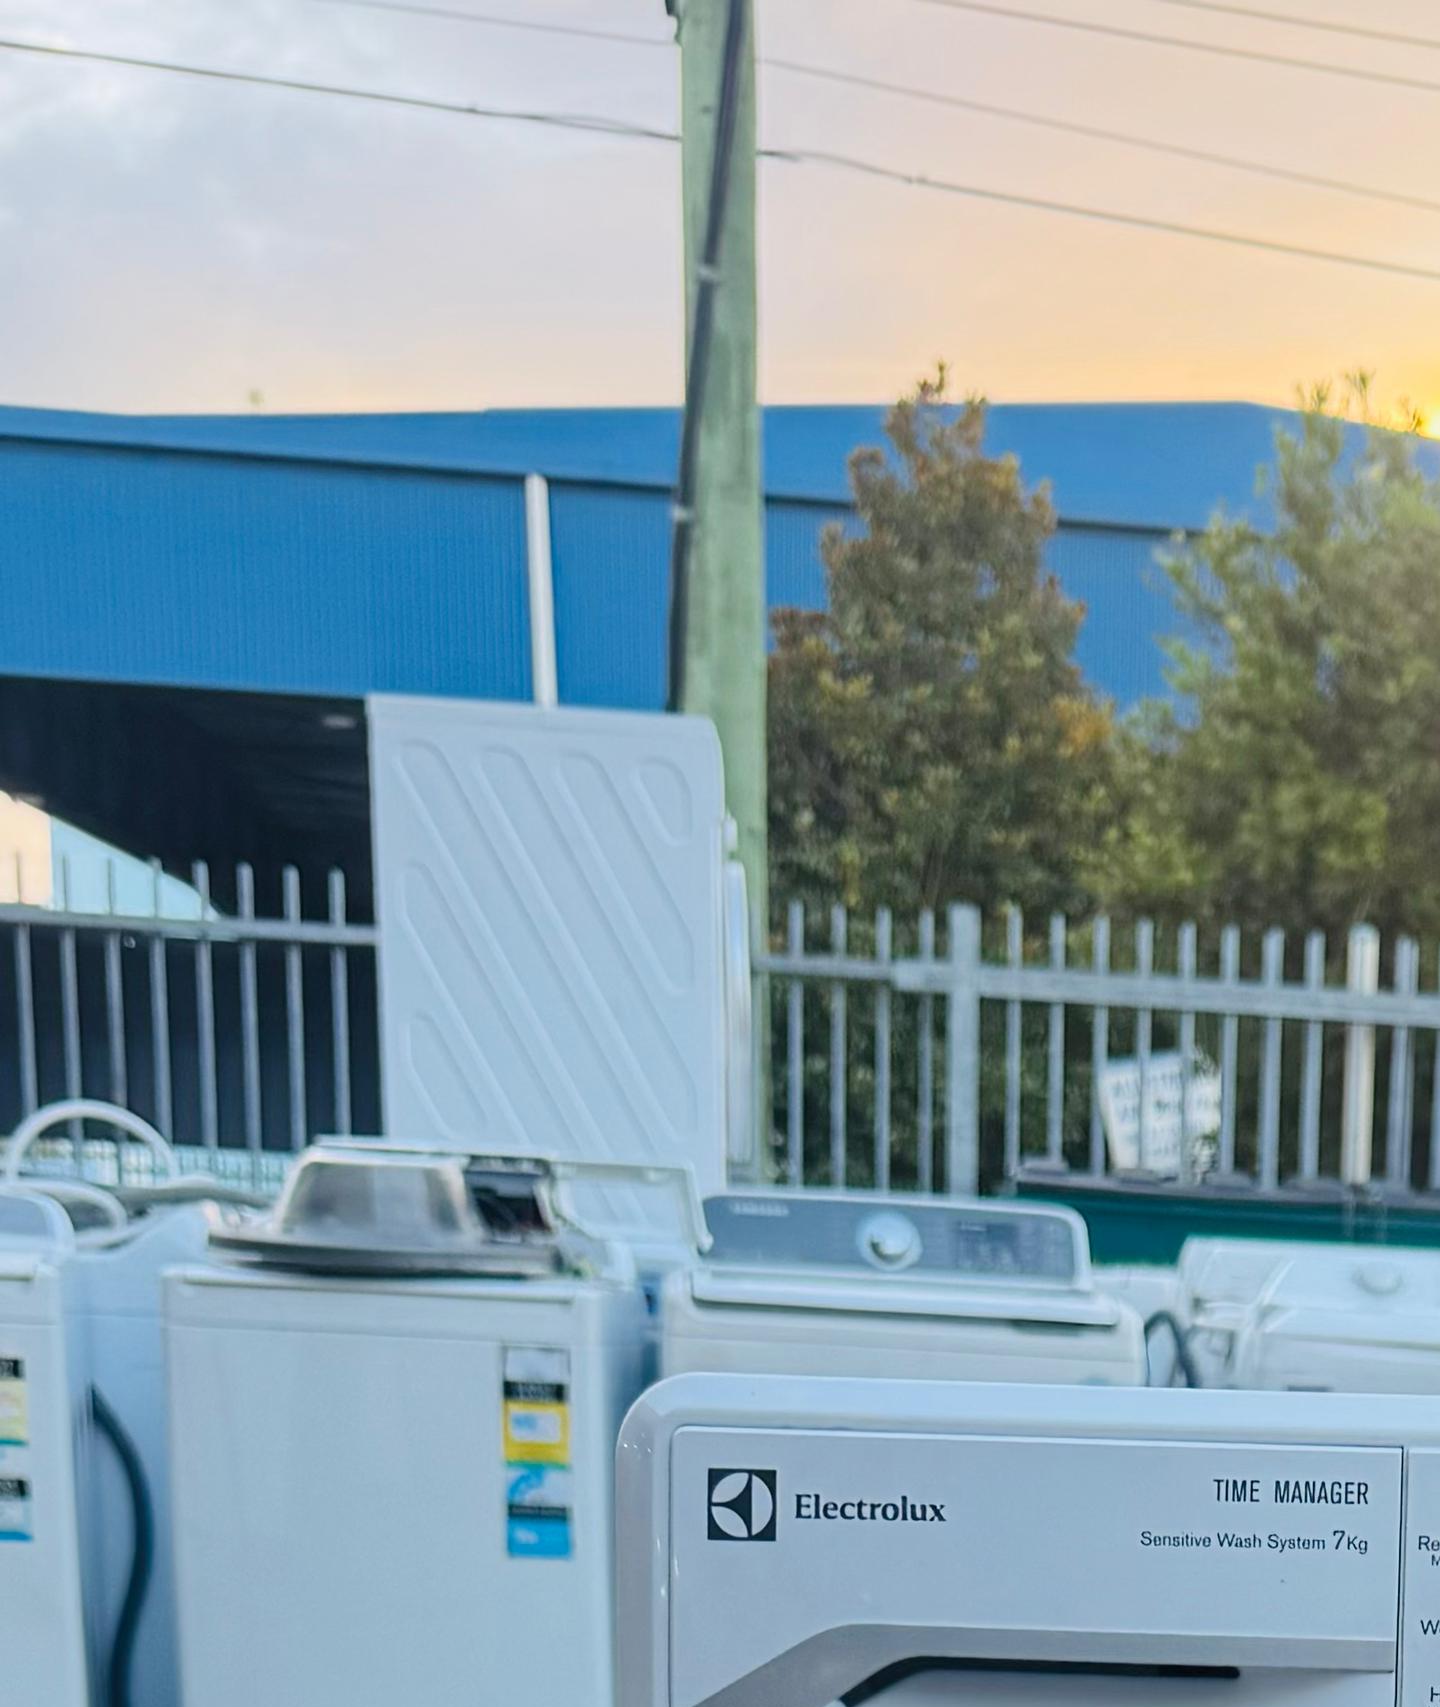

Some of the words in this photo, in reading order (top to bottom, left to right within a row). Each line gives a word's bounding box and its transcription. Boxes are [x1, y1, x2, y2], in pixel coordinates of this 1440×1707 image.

[1213, 1479, 1260, 1502] TIME
[1275, 1480, 1368, 1504] MANAGER
[795, 1494, 946, 1521] Electrolux
[1141, 1531, 1211, 1547] Sensitive
[1217, 1533, 1261, 1548] Wash
[1267, 1534, 1325, 1553] System
[1333, 1530, 1368, 1554] 7Kg
